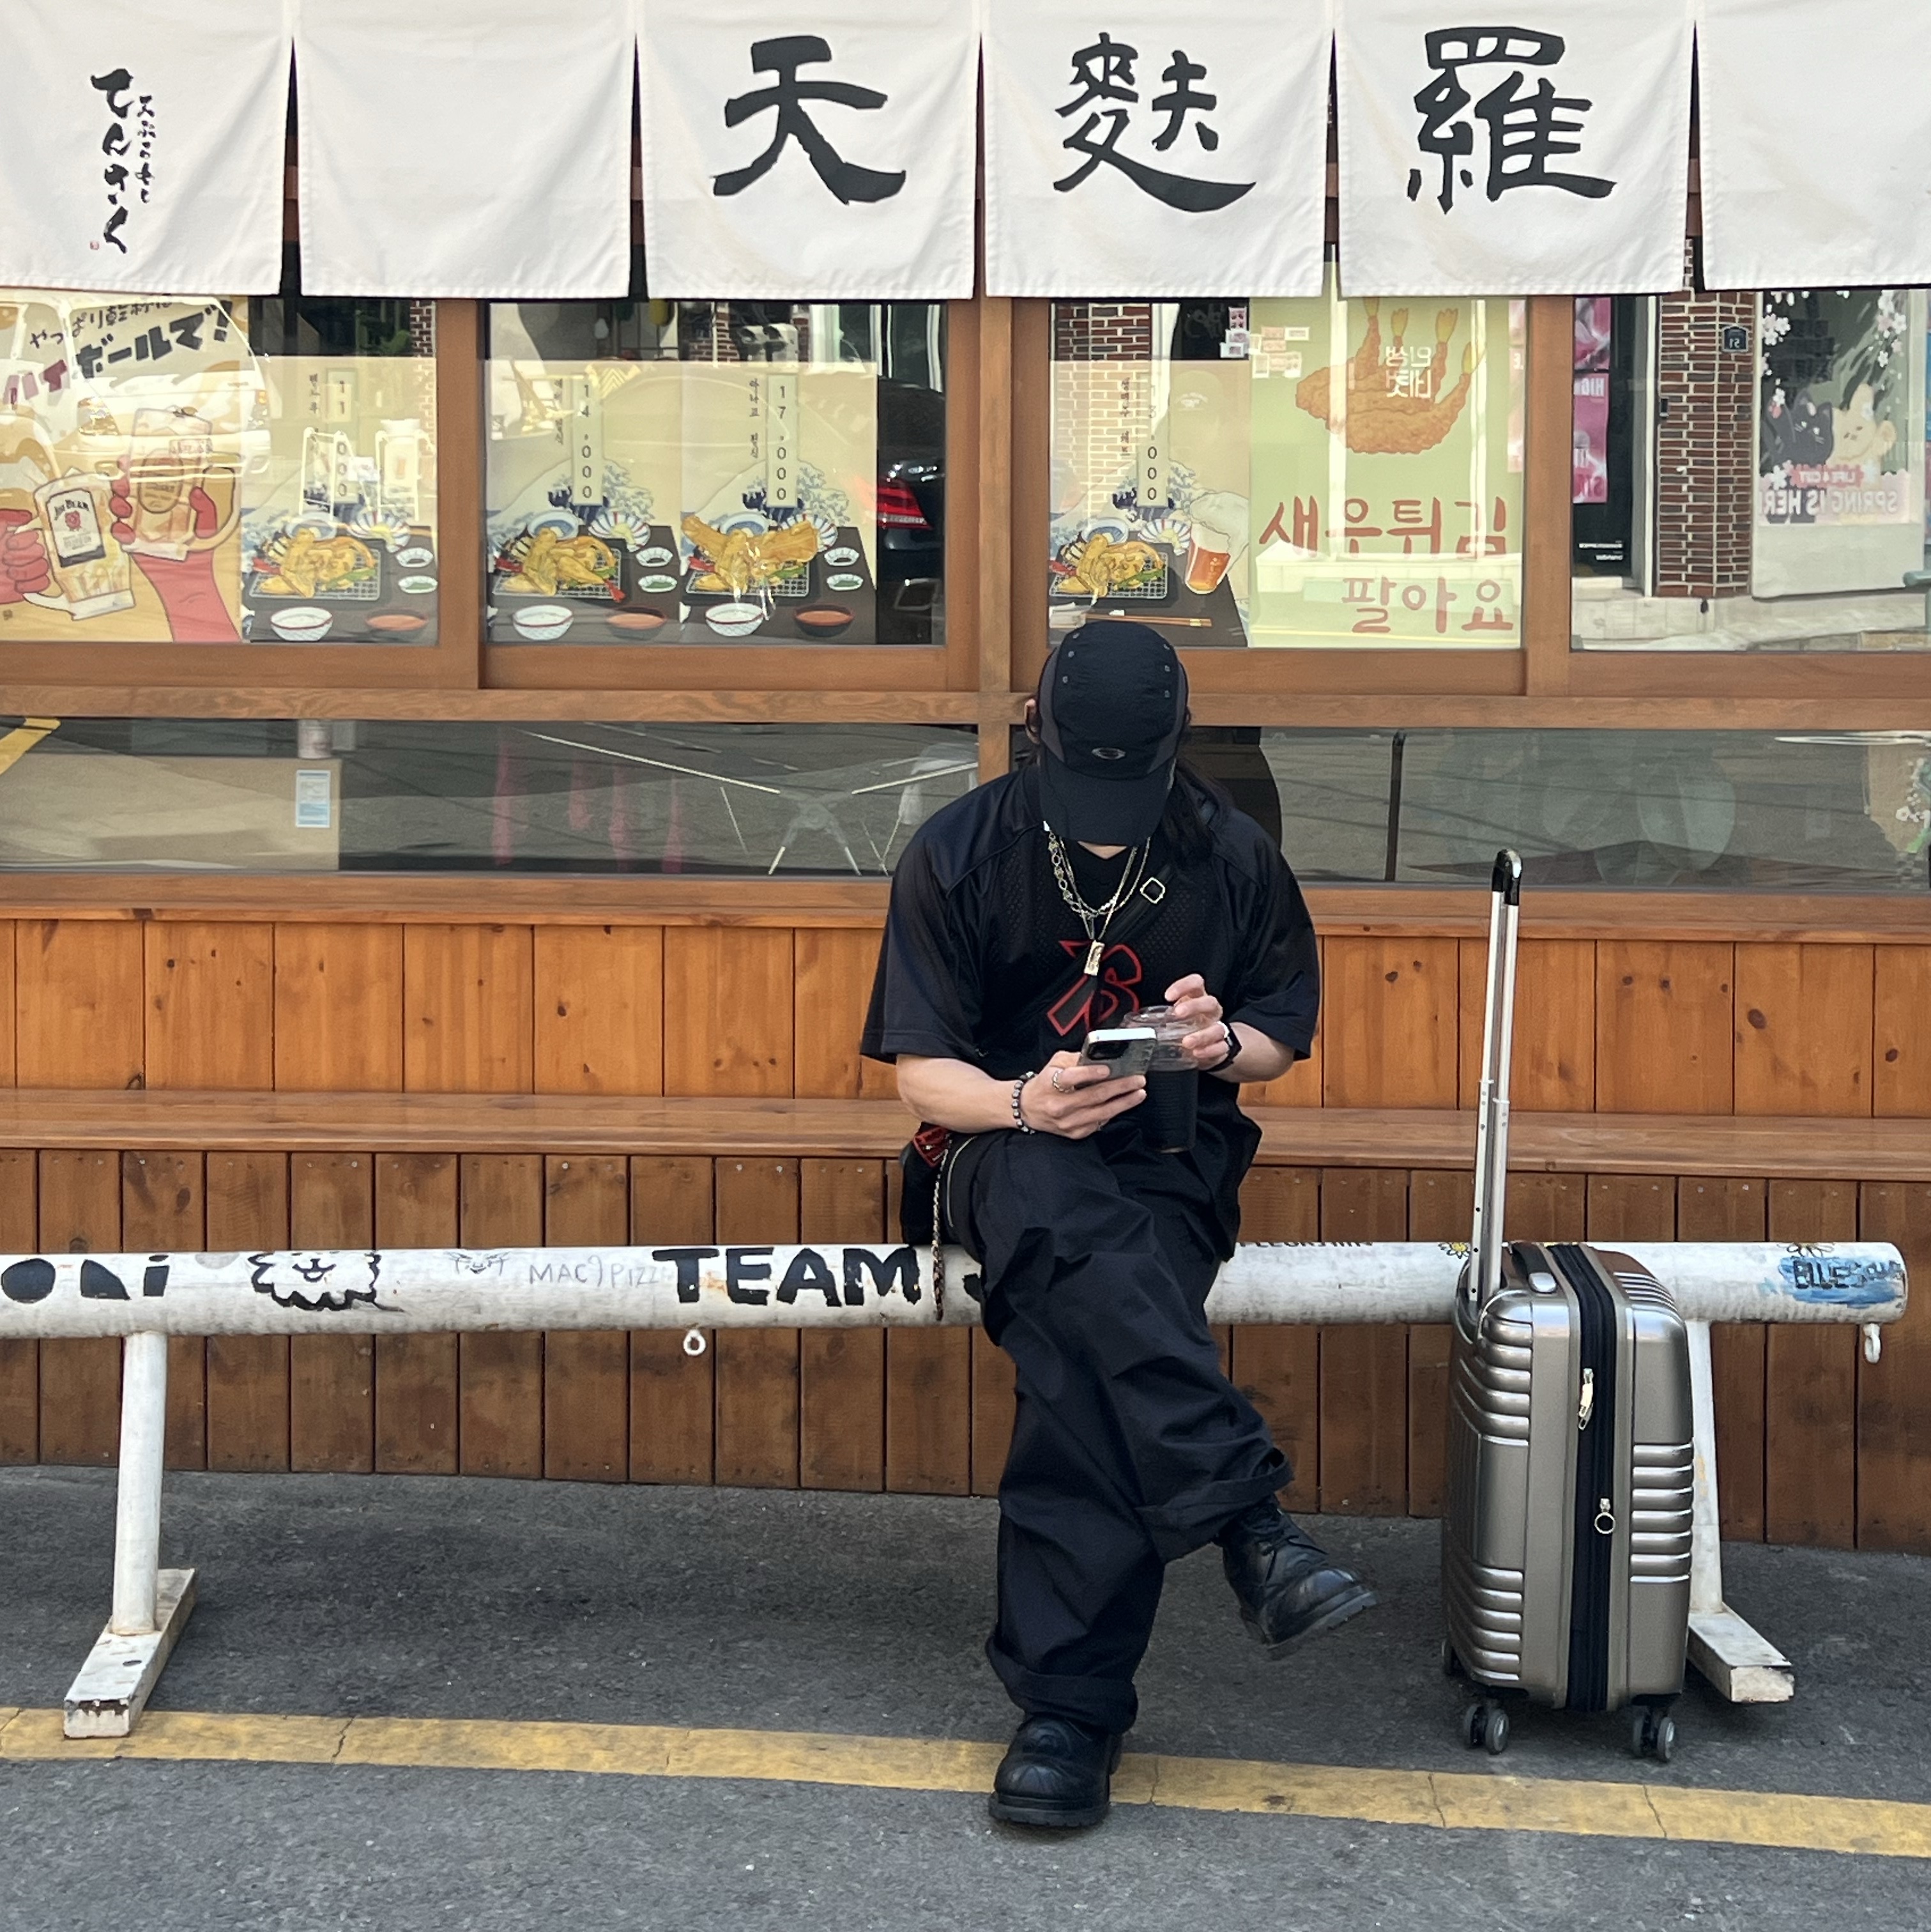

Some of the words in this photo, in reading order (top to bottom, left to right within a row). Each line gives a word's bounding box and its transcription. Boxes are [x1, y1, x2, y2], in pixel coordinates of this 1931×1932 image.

[1258, 496, 1506, 559] 새우튀김
[1341, 576, 1514, 633] 팔아요
[652, 1246, 922, 1308] TEAM
